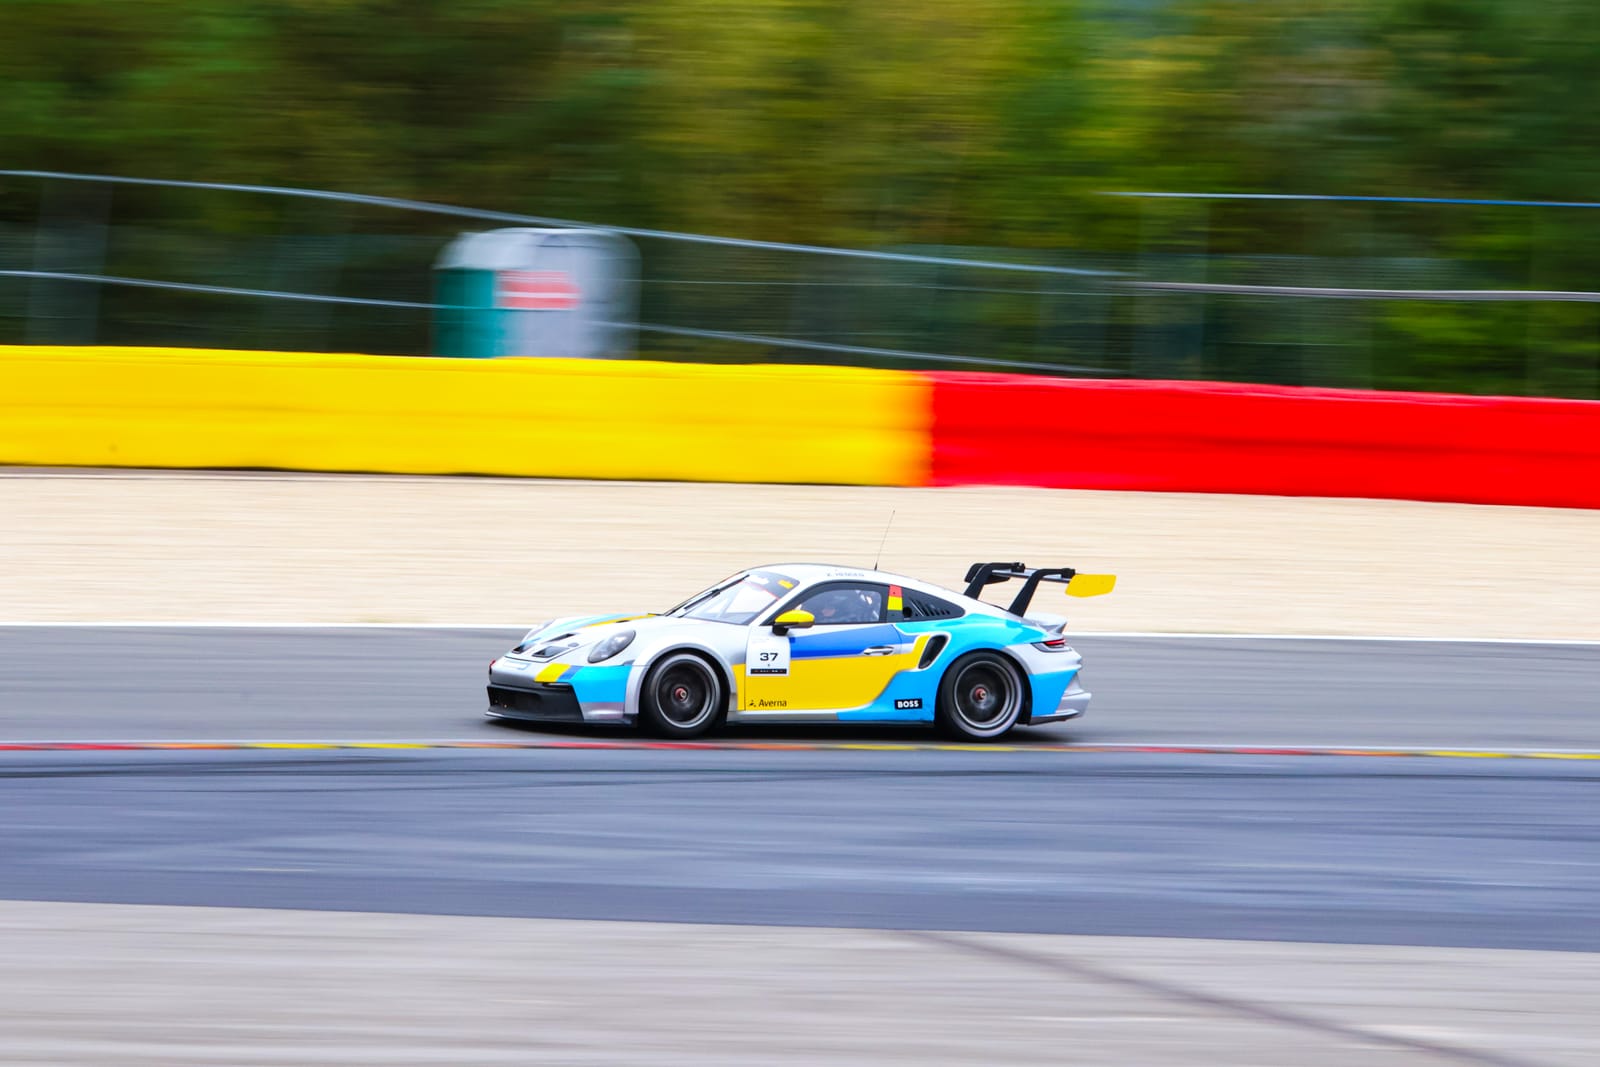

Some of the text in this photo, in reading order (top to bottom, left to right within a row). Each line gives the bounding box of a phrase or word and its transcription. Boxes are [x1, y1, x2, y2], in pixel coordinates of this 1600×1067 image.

[760, 652, 778, 661] 37
[758, 699, 787, 707] Averna
[897, 700, 919, 708] BOSS
